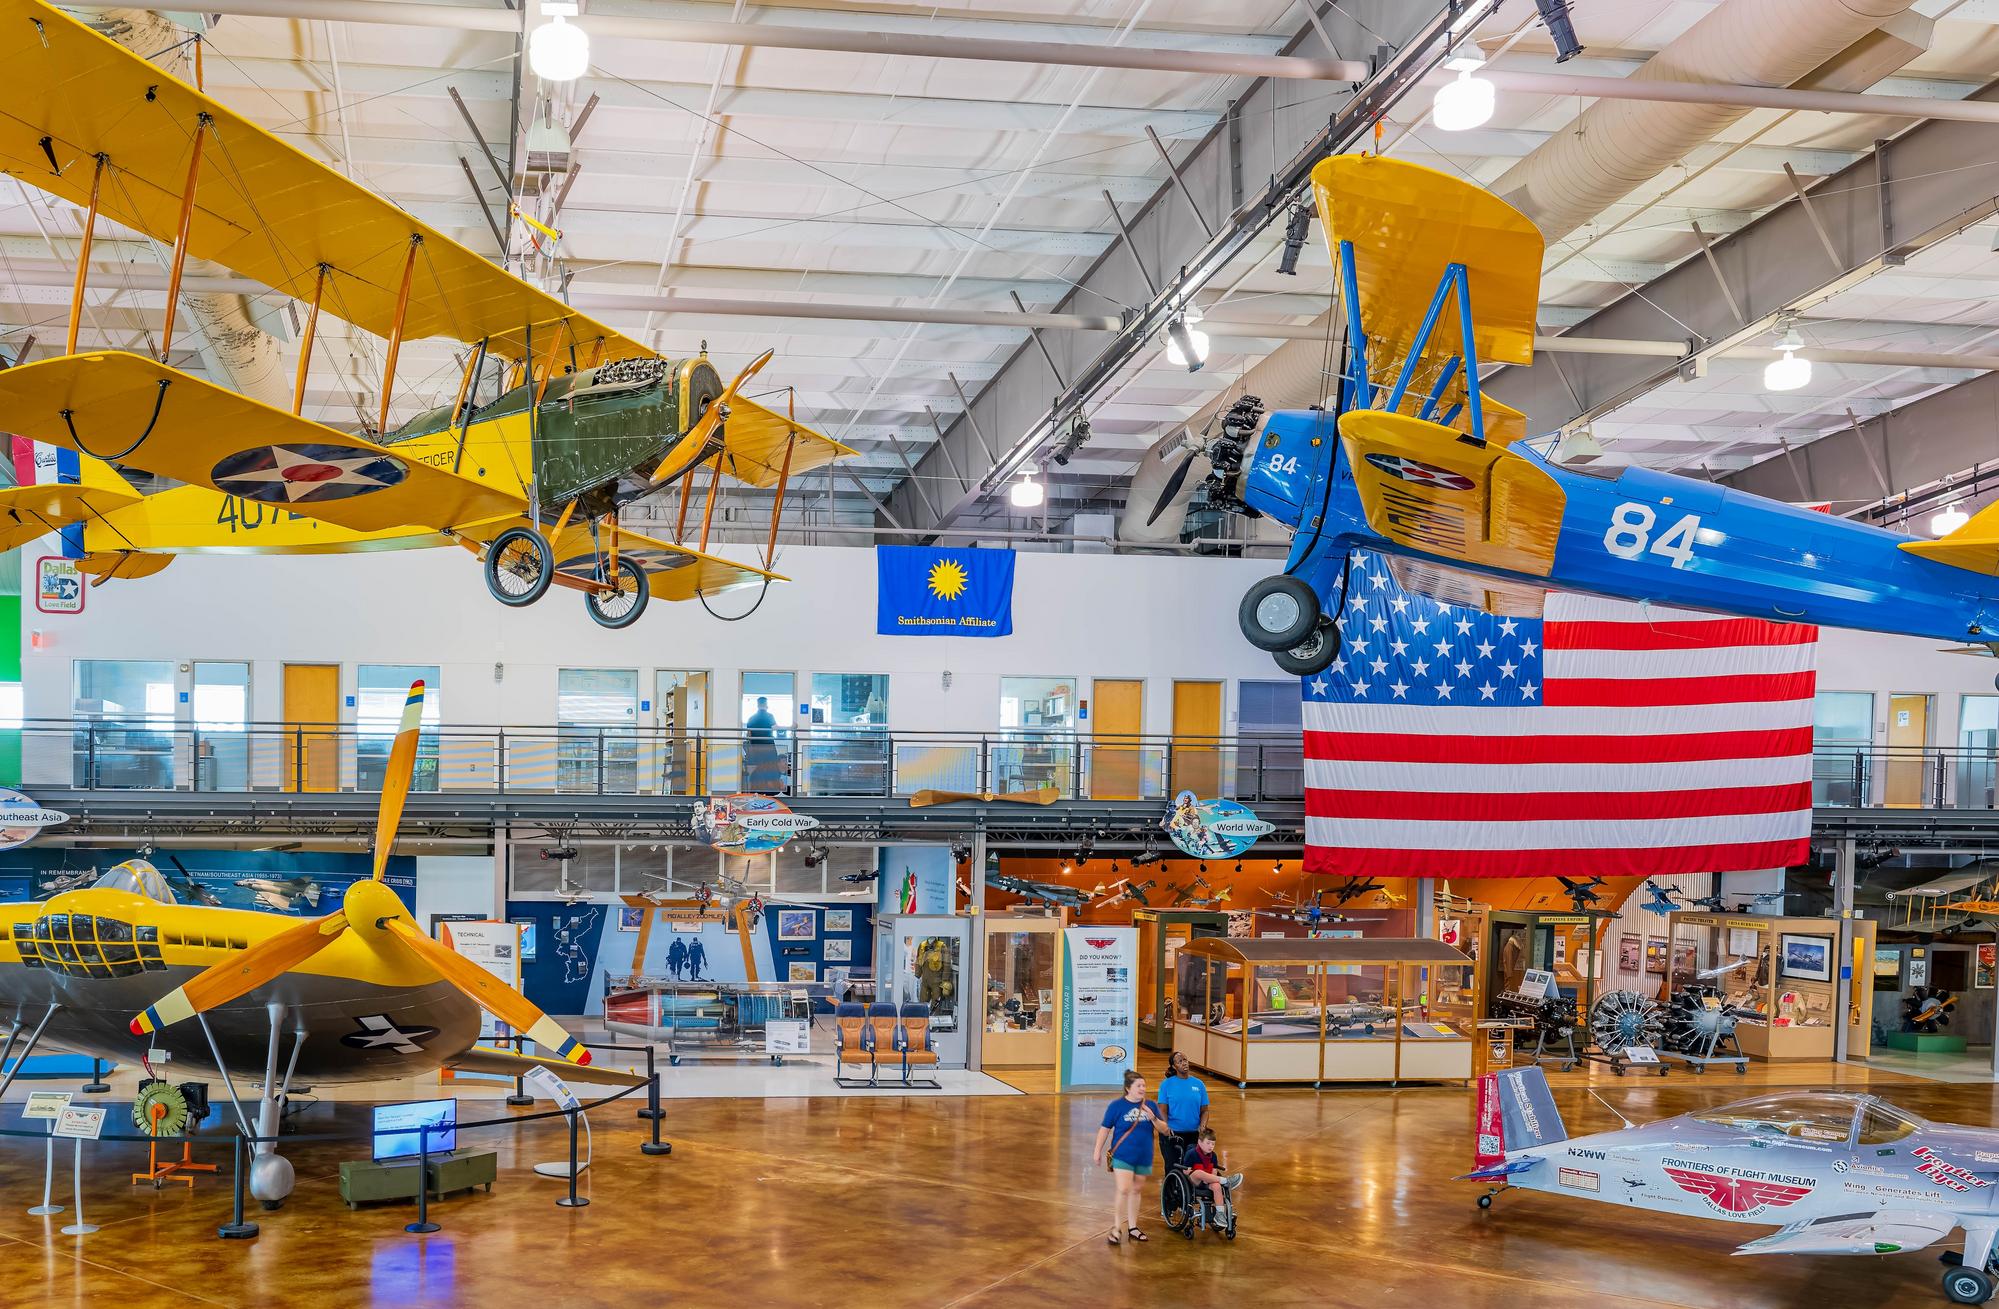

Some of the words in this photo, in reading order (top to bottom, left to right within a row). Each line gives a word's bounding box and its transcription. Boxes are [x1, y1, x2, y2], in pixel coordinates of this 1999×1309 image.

[417, 450, 455, 467] FICER
[1269, 453, 1299, 475] 84
[1603, 501, 1701, 570] 84
[898, 615, 956, 626] Smithsonian
[959, 616, 997, 627] Affiliate
[41, 813, 62, 822] Asia
[747, 818, 769, 827] Early
[771, 818, 792, 827] Cold
[795, 819, 813, 827] War
[1216, 823, 1243, 832] World
[1245, 823, 1263, 832] War
[1265, 824, 1271, 832] II
[1525, 1102, 1543, 1140] Stabilizer
[1567, 1147, 1606, 1161] N2WW
[1661, 1157, 1714, 1173] FRONTIERS
[1716, 1166, 1729, 1175] OF
[1731, 1168, 1766, 1180] FLIGHT
[1767, 1173, 1817, 1187] MUSEUM
[1910, 1145, 1990, 1188] Frontier
[1914, 1162, 1970, 1192] Flyer
[1844, 1182, 1866, 1191] Wing
[1875, 1185, 1922, 1196] Generates
[1702, 1196, 1727, 1217] DALLAS
[1728, 1211, 1747, 1219] LOVE
[1747, 1205, 1767, 1217] FIELD
